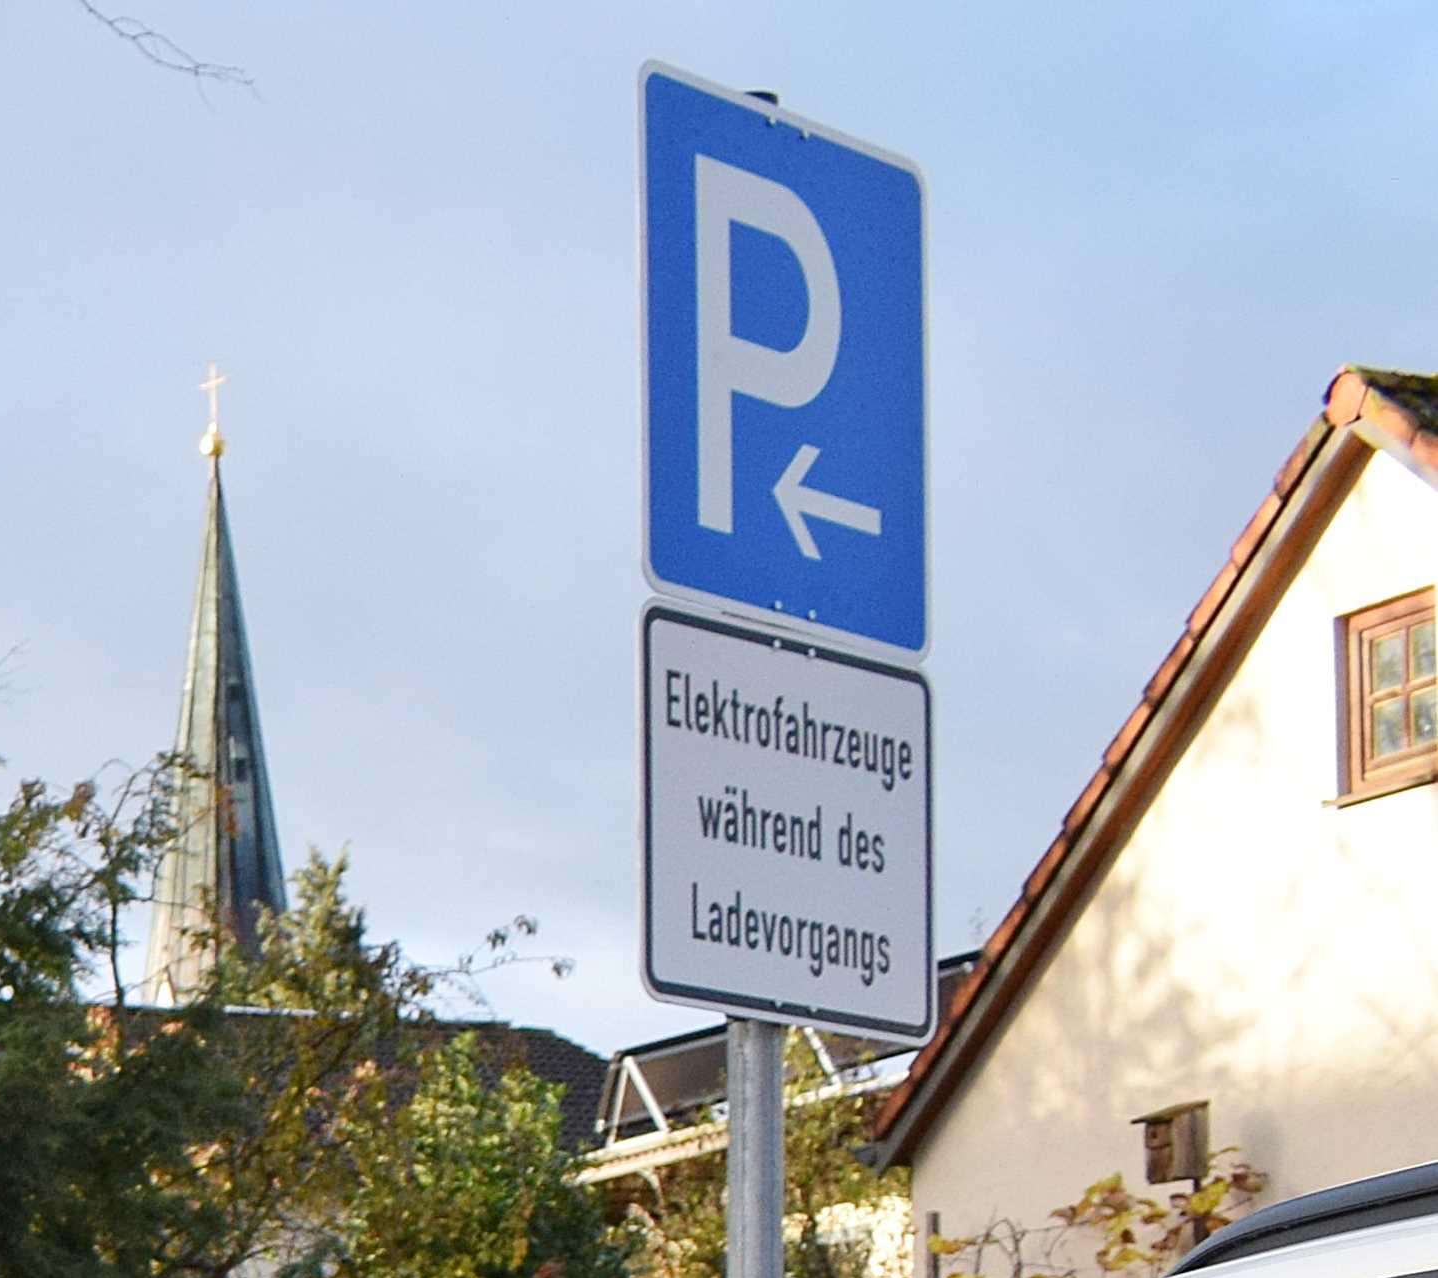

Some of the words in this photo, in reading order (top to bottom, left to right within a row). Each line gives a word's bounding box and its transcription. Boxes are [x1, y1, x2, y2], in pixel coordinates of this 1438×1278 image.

[696, 154, 841, 533] P
[665, 668, 913, 793] Elektrofahrzeuge
[697, 785, 822, 862] während
[837, 811, 886, 875] des
[691, 881, 891, 988] Ladevorgangs
